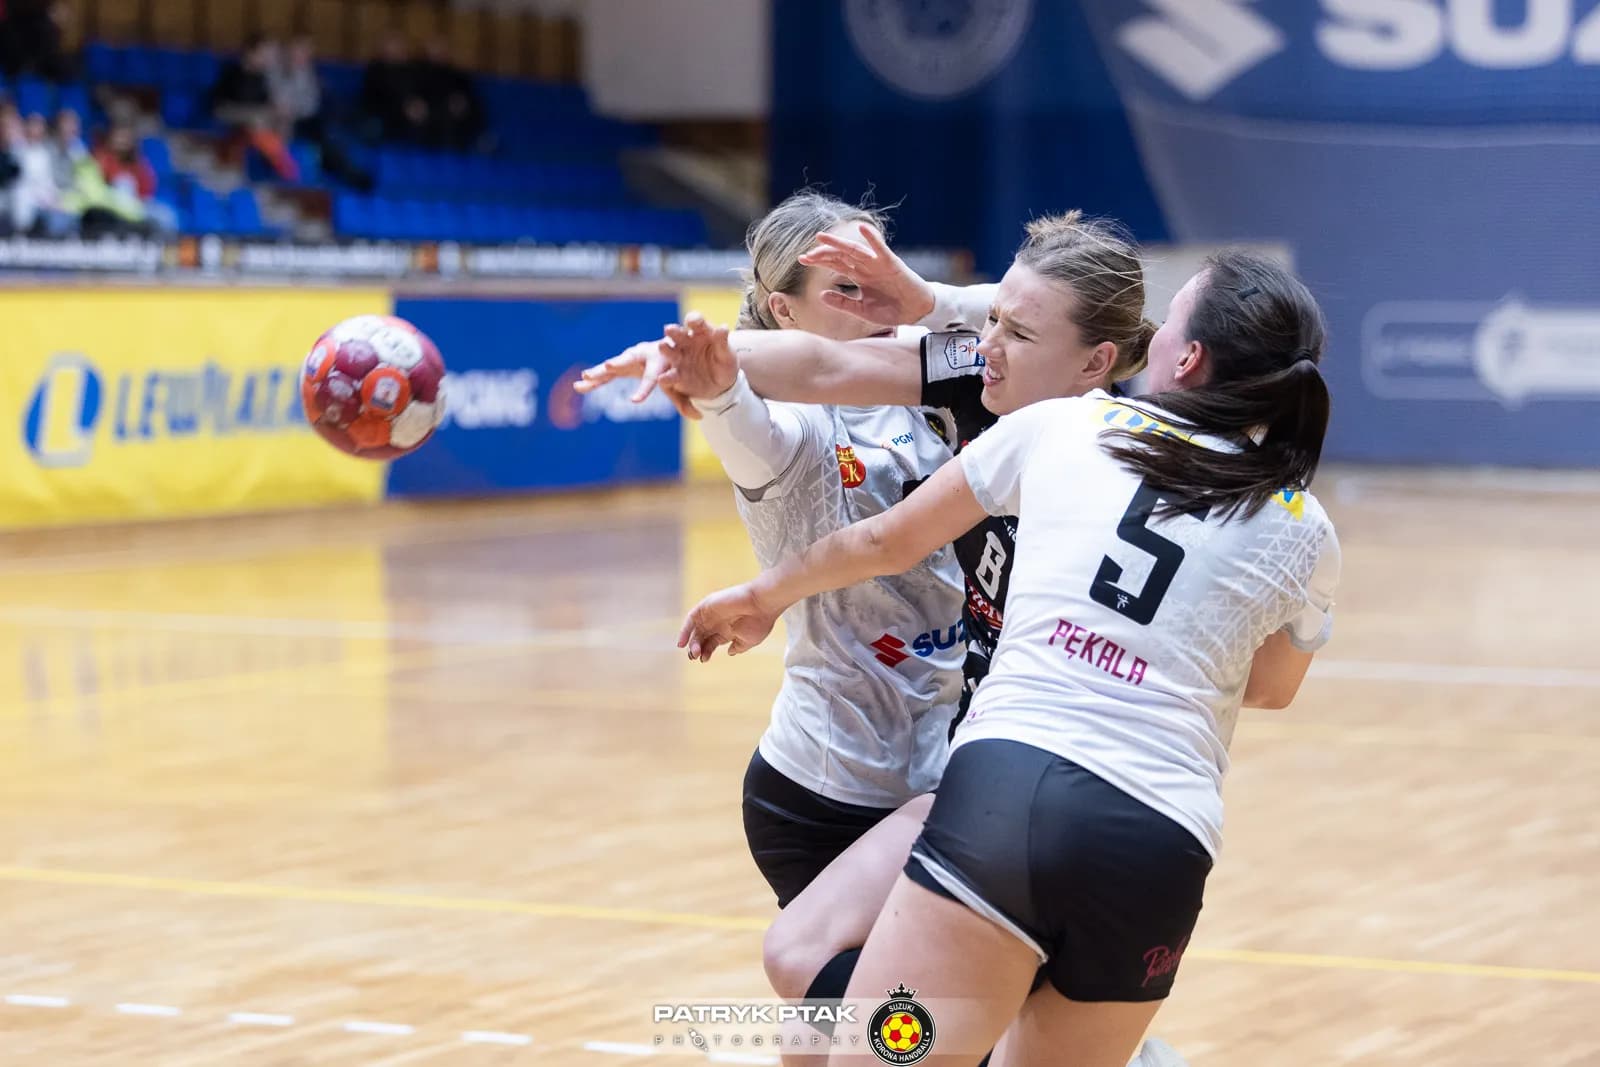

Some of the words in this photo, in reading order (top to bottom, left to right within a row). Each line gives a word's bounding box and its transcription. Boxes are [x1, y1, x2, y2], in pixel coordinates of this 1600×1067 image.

[1314, 0, 1600, 71] SU
[113, 360, 306, 438] LEWIATA
[891, 431, 914, 446] PGN
[1089, 474, 1211, 626] 5
[1048, 618, 1148, 686] PĘKALA
